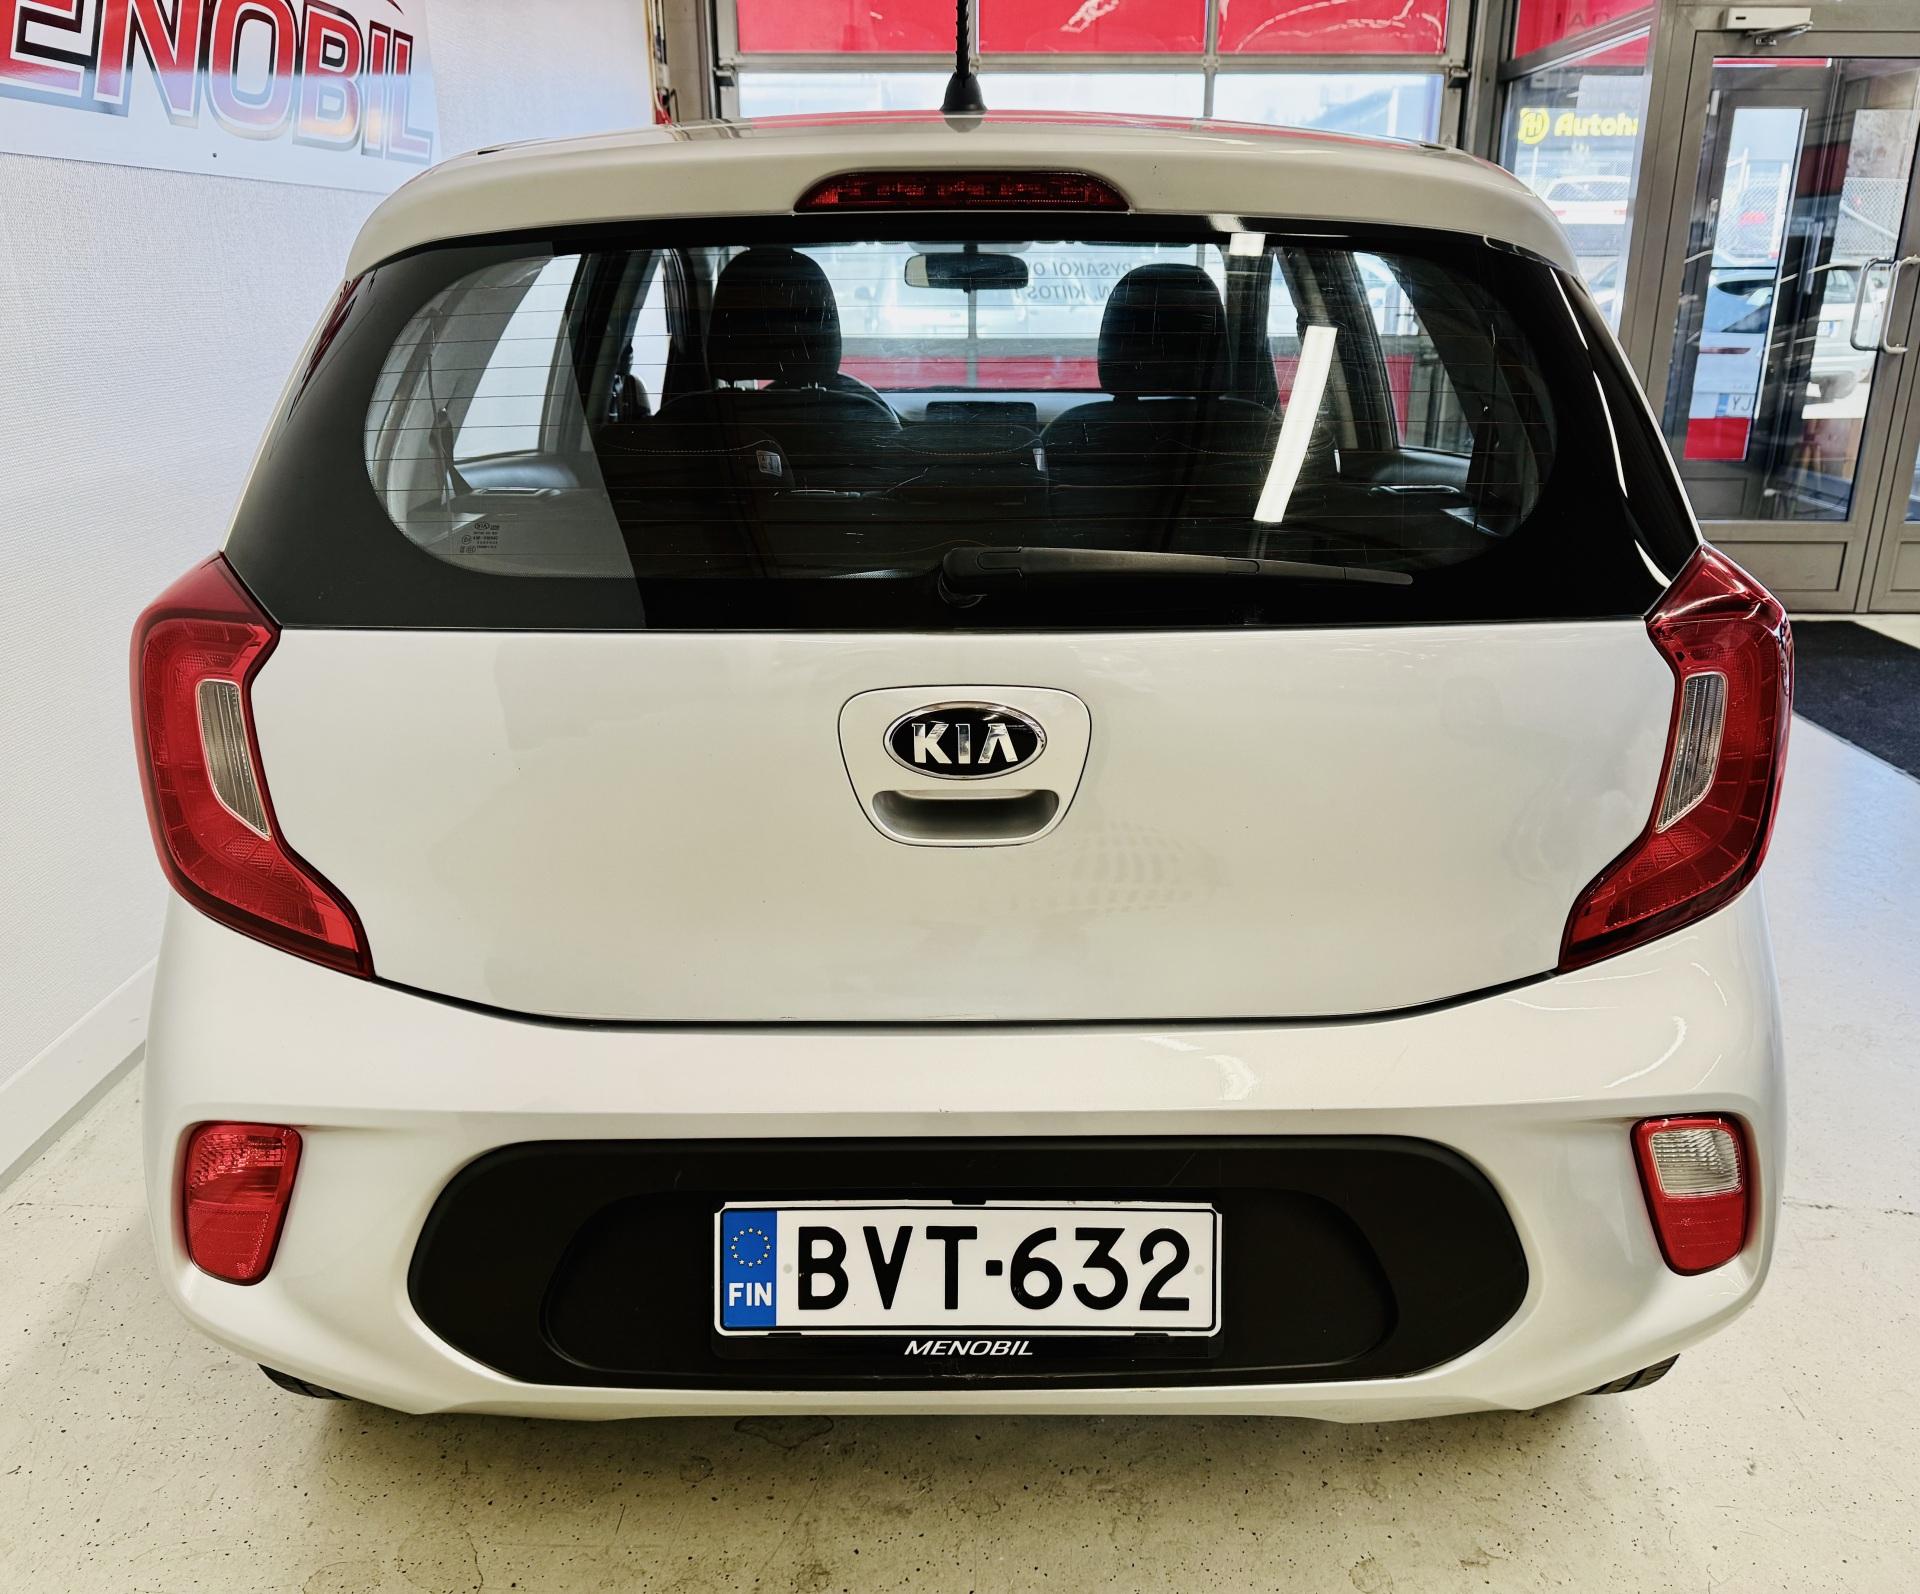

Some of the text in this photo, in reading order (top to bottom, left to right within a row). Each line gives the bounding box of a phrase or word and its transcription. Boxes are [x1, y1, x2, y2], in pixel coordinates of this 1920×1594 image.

[911, 722, 1019, 765] KIA
[728, 1225, 1191, 1311] FIN BVT-632
[903, 1340, 1034, 1356] MENOBIL
